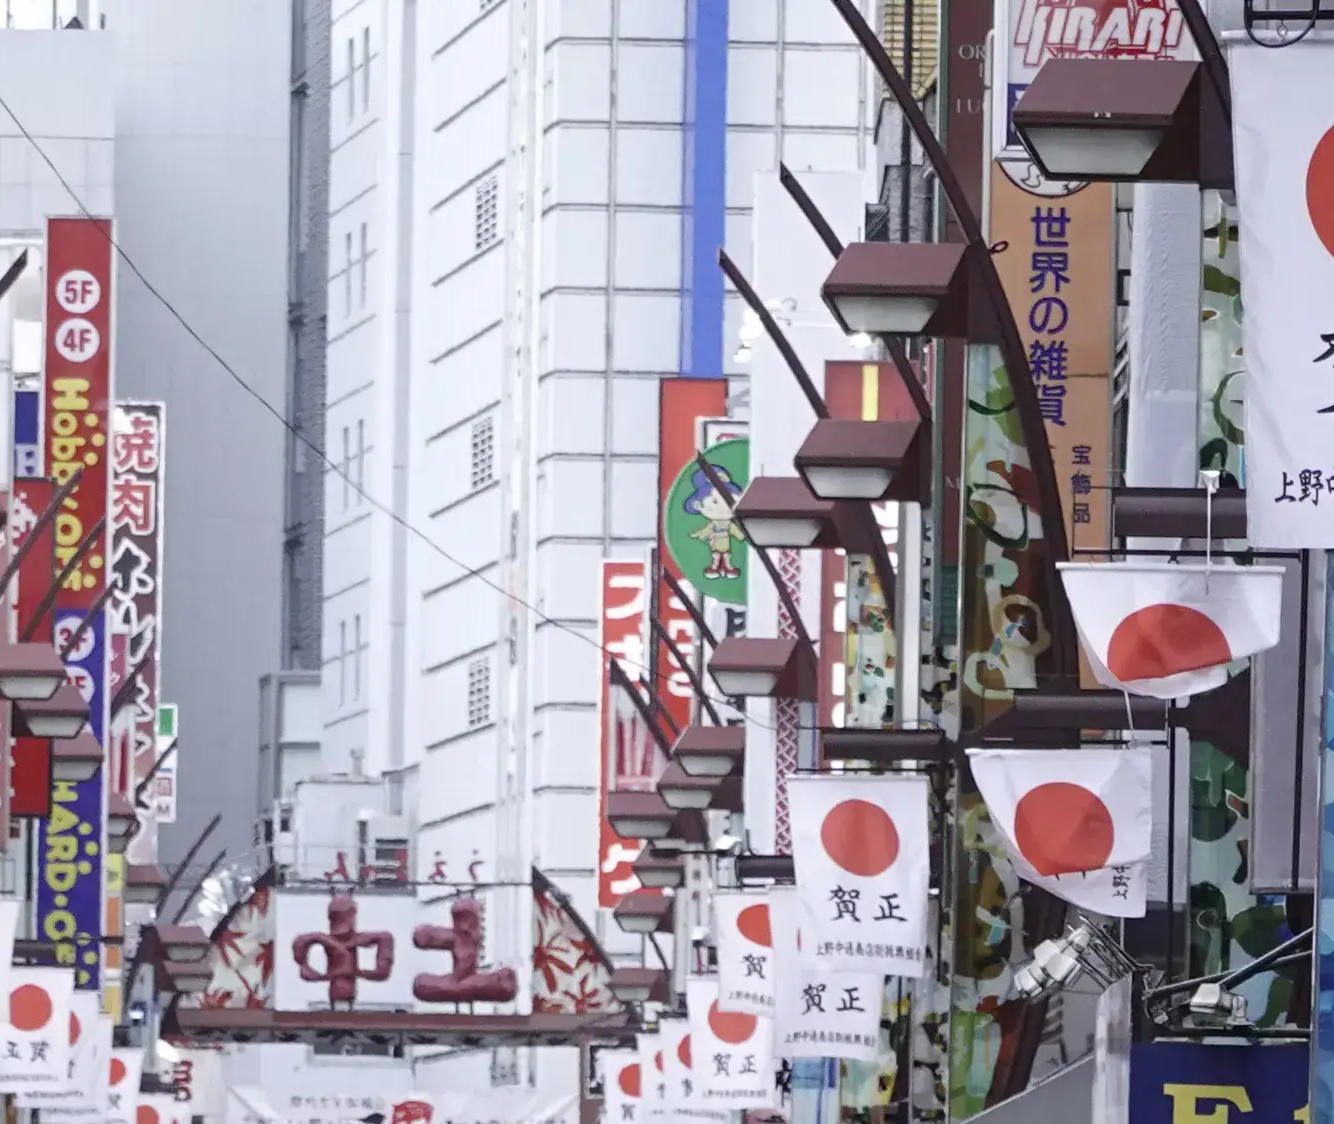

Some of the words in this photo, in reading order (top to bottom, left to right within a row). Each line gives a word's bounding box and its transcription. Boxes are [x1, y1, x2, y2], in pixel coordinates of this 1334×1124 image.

[63, 279, 94, 305] 5F
[63, 327, 94, 353] 4F
[827, 884, 909, 924] 賀正
[802, 983, 867, 1016] 賀正
